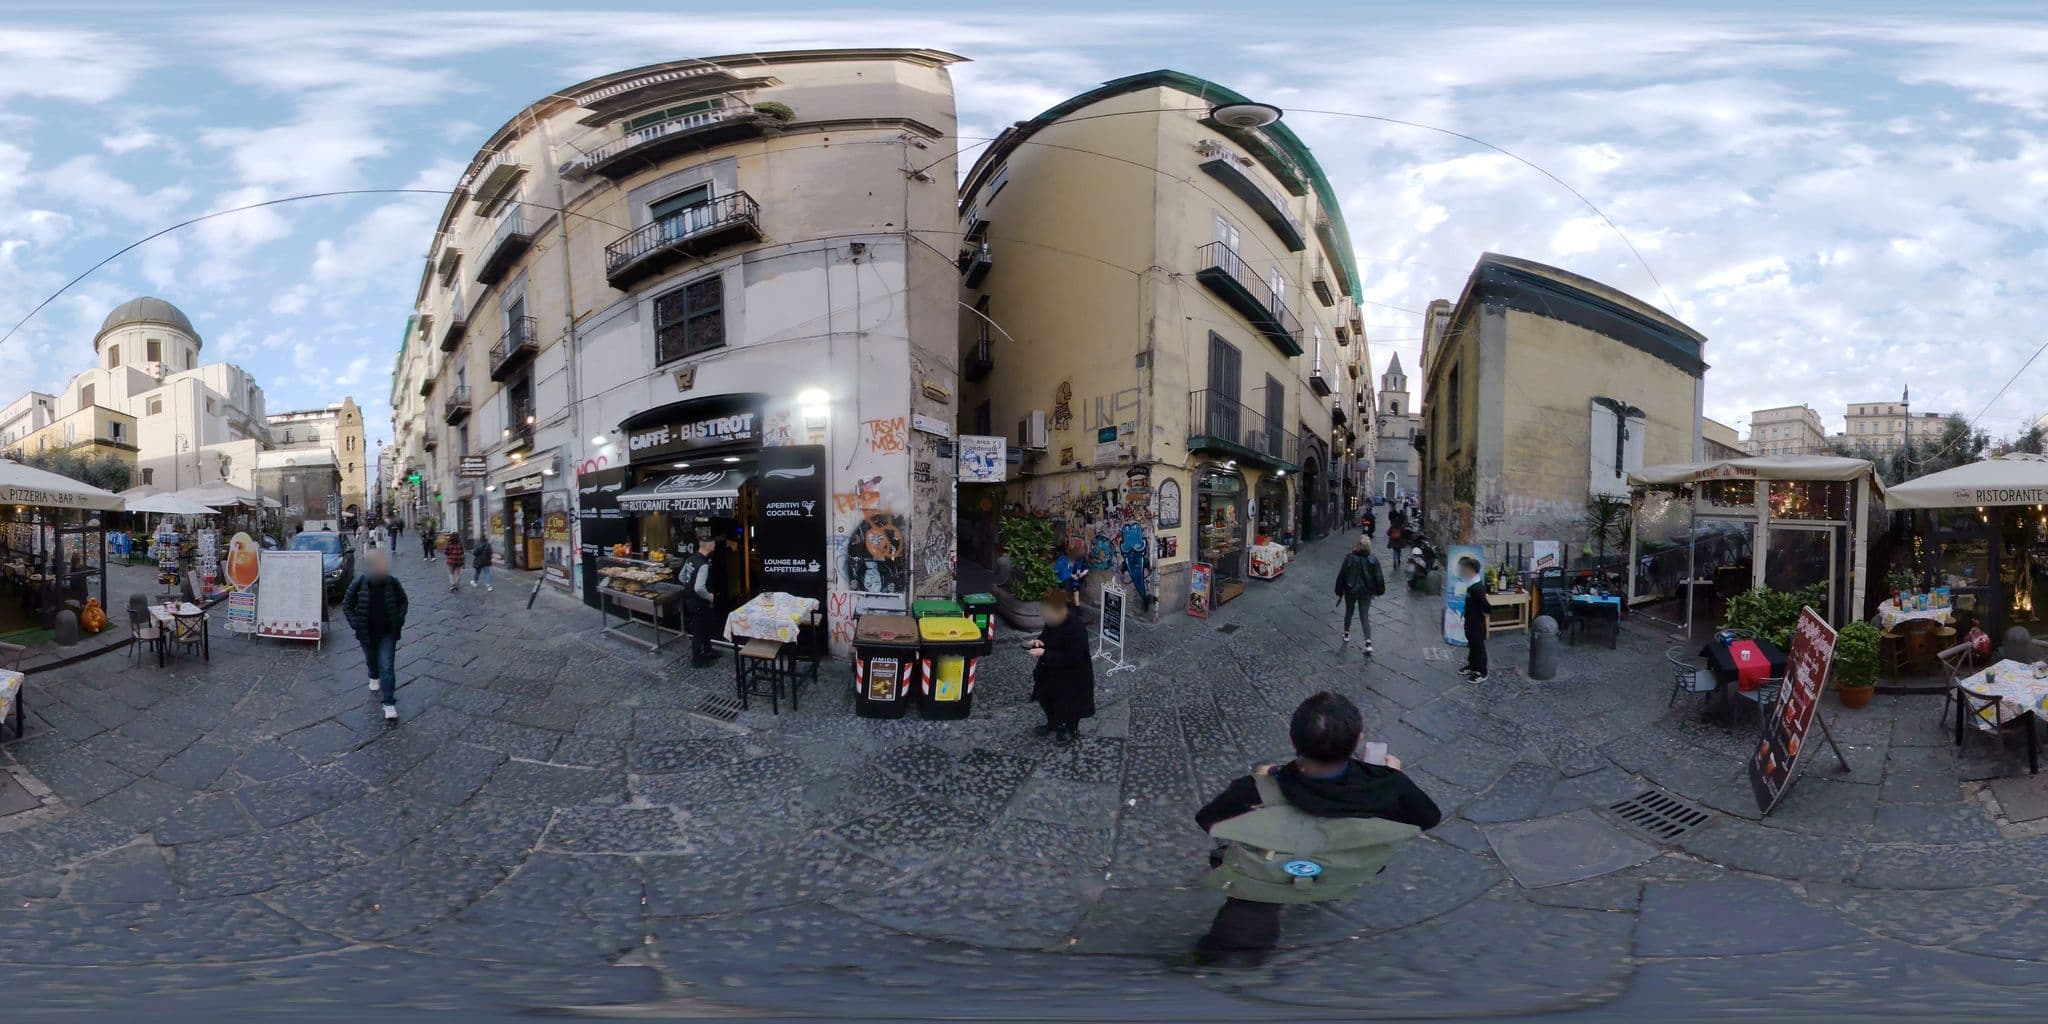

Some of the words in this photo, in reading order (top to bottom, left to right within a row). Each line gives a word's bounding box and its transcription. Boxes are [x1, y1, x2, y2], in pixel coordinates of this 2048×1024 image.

[630, 424, 670, 450] CAFFÈ
[680, 413, 754, 440] BISTROT
[9, 488, 48, 502] PIZZERIA
[59, 492, 73, 504] BAR
[1976, 489, 2043, 502] RISTORANTE
